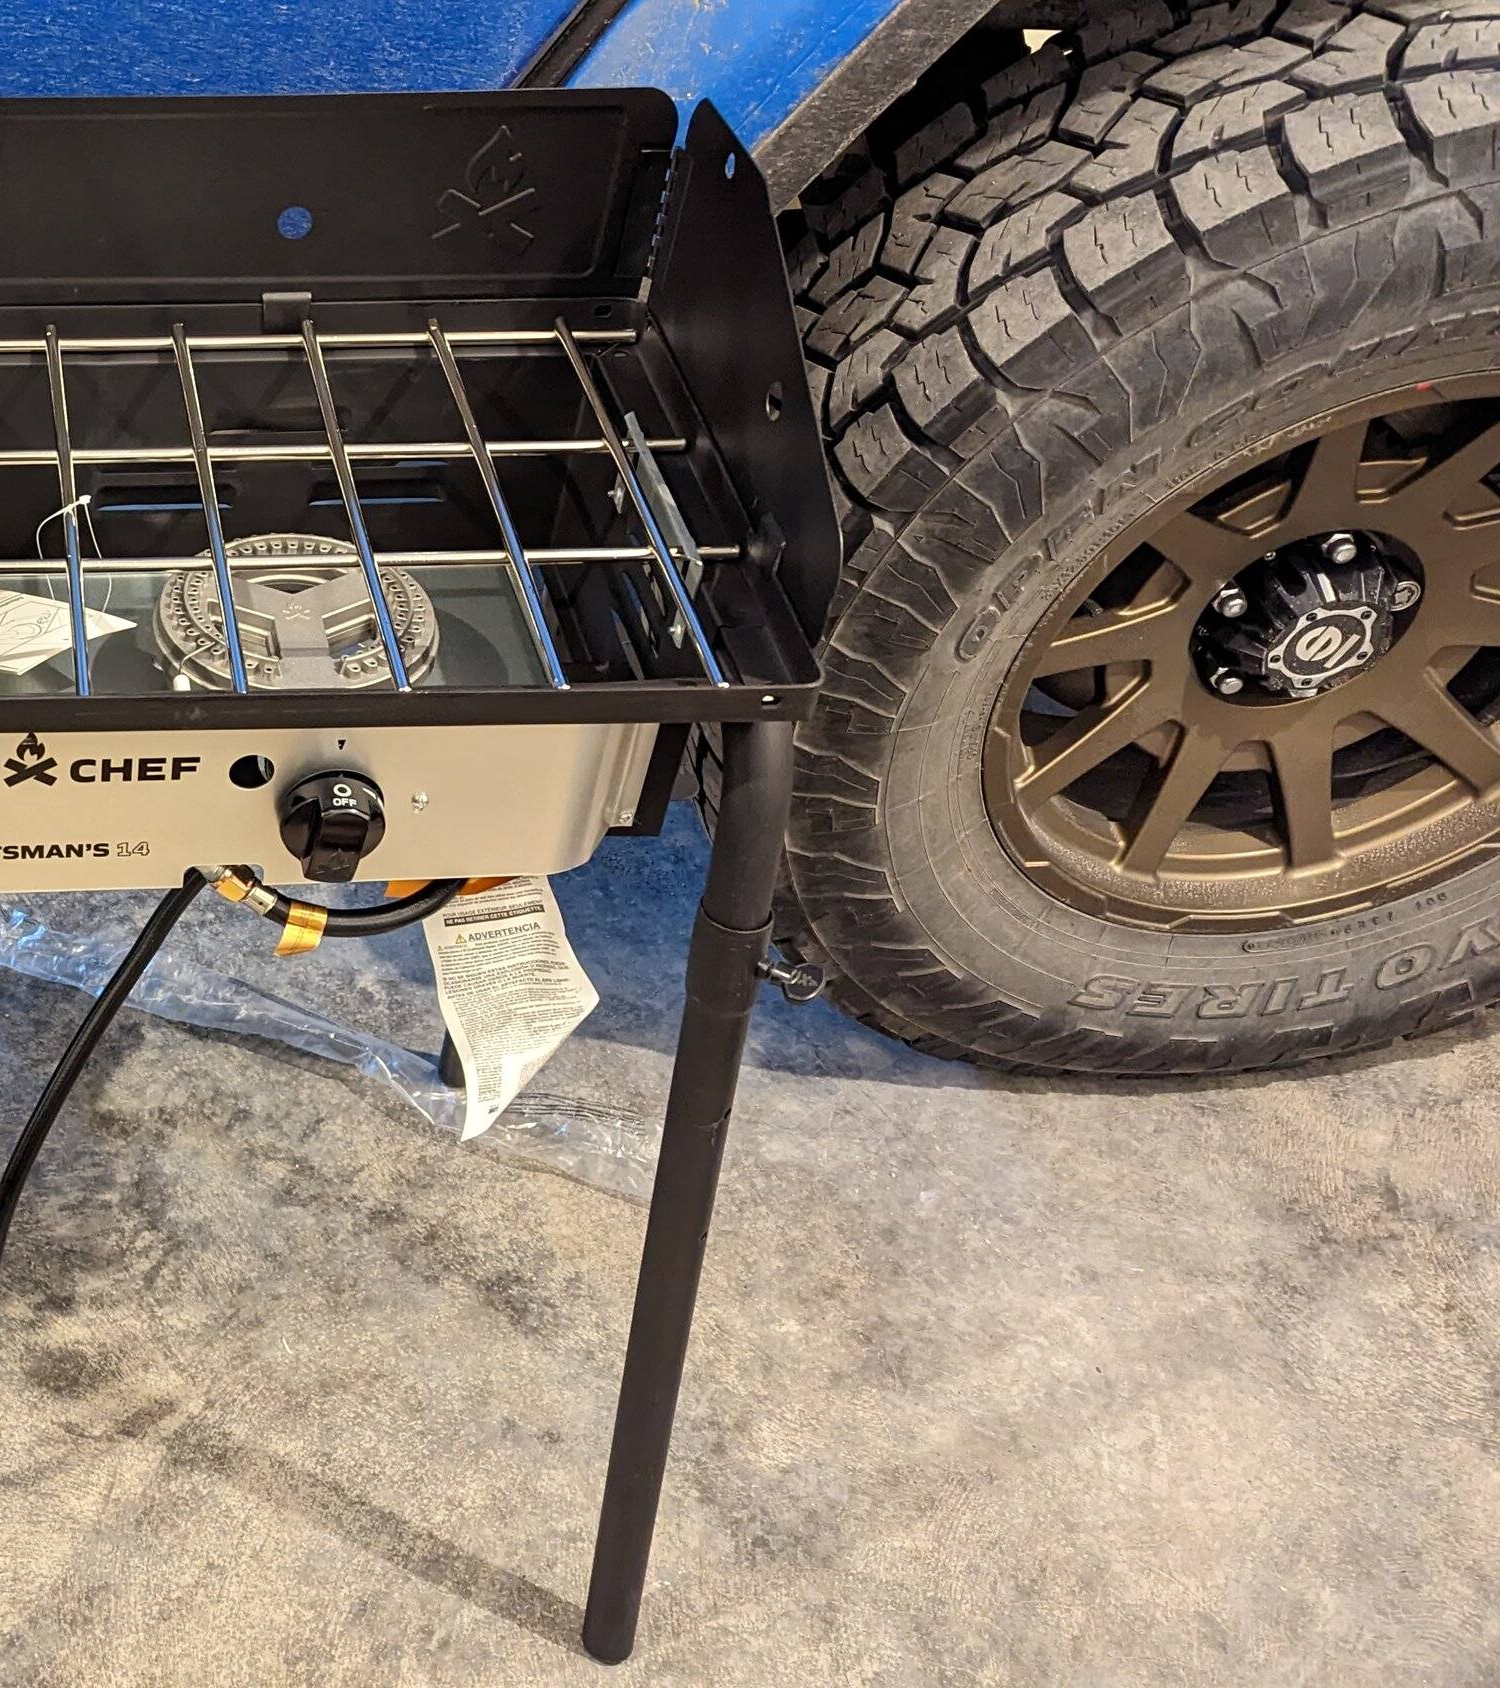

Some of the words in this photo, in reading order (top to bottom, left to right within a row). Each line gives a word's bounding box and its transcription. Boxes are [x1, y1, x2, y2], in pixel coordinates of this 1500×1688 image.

[70, 756, 201, 783] CHEF
[333, 798, 357, 807] OFF
[117, 841, 150, 857] 14
[468, 922, 541, 942] ADVERTENCIA
[1070, 967, 1355, 1020] TIRES
